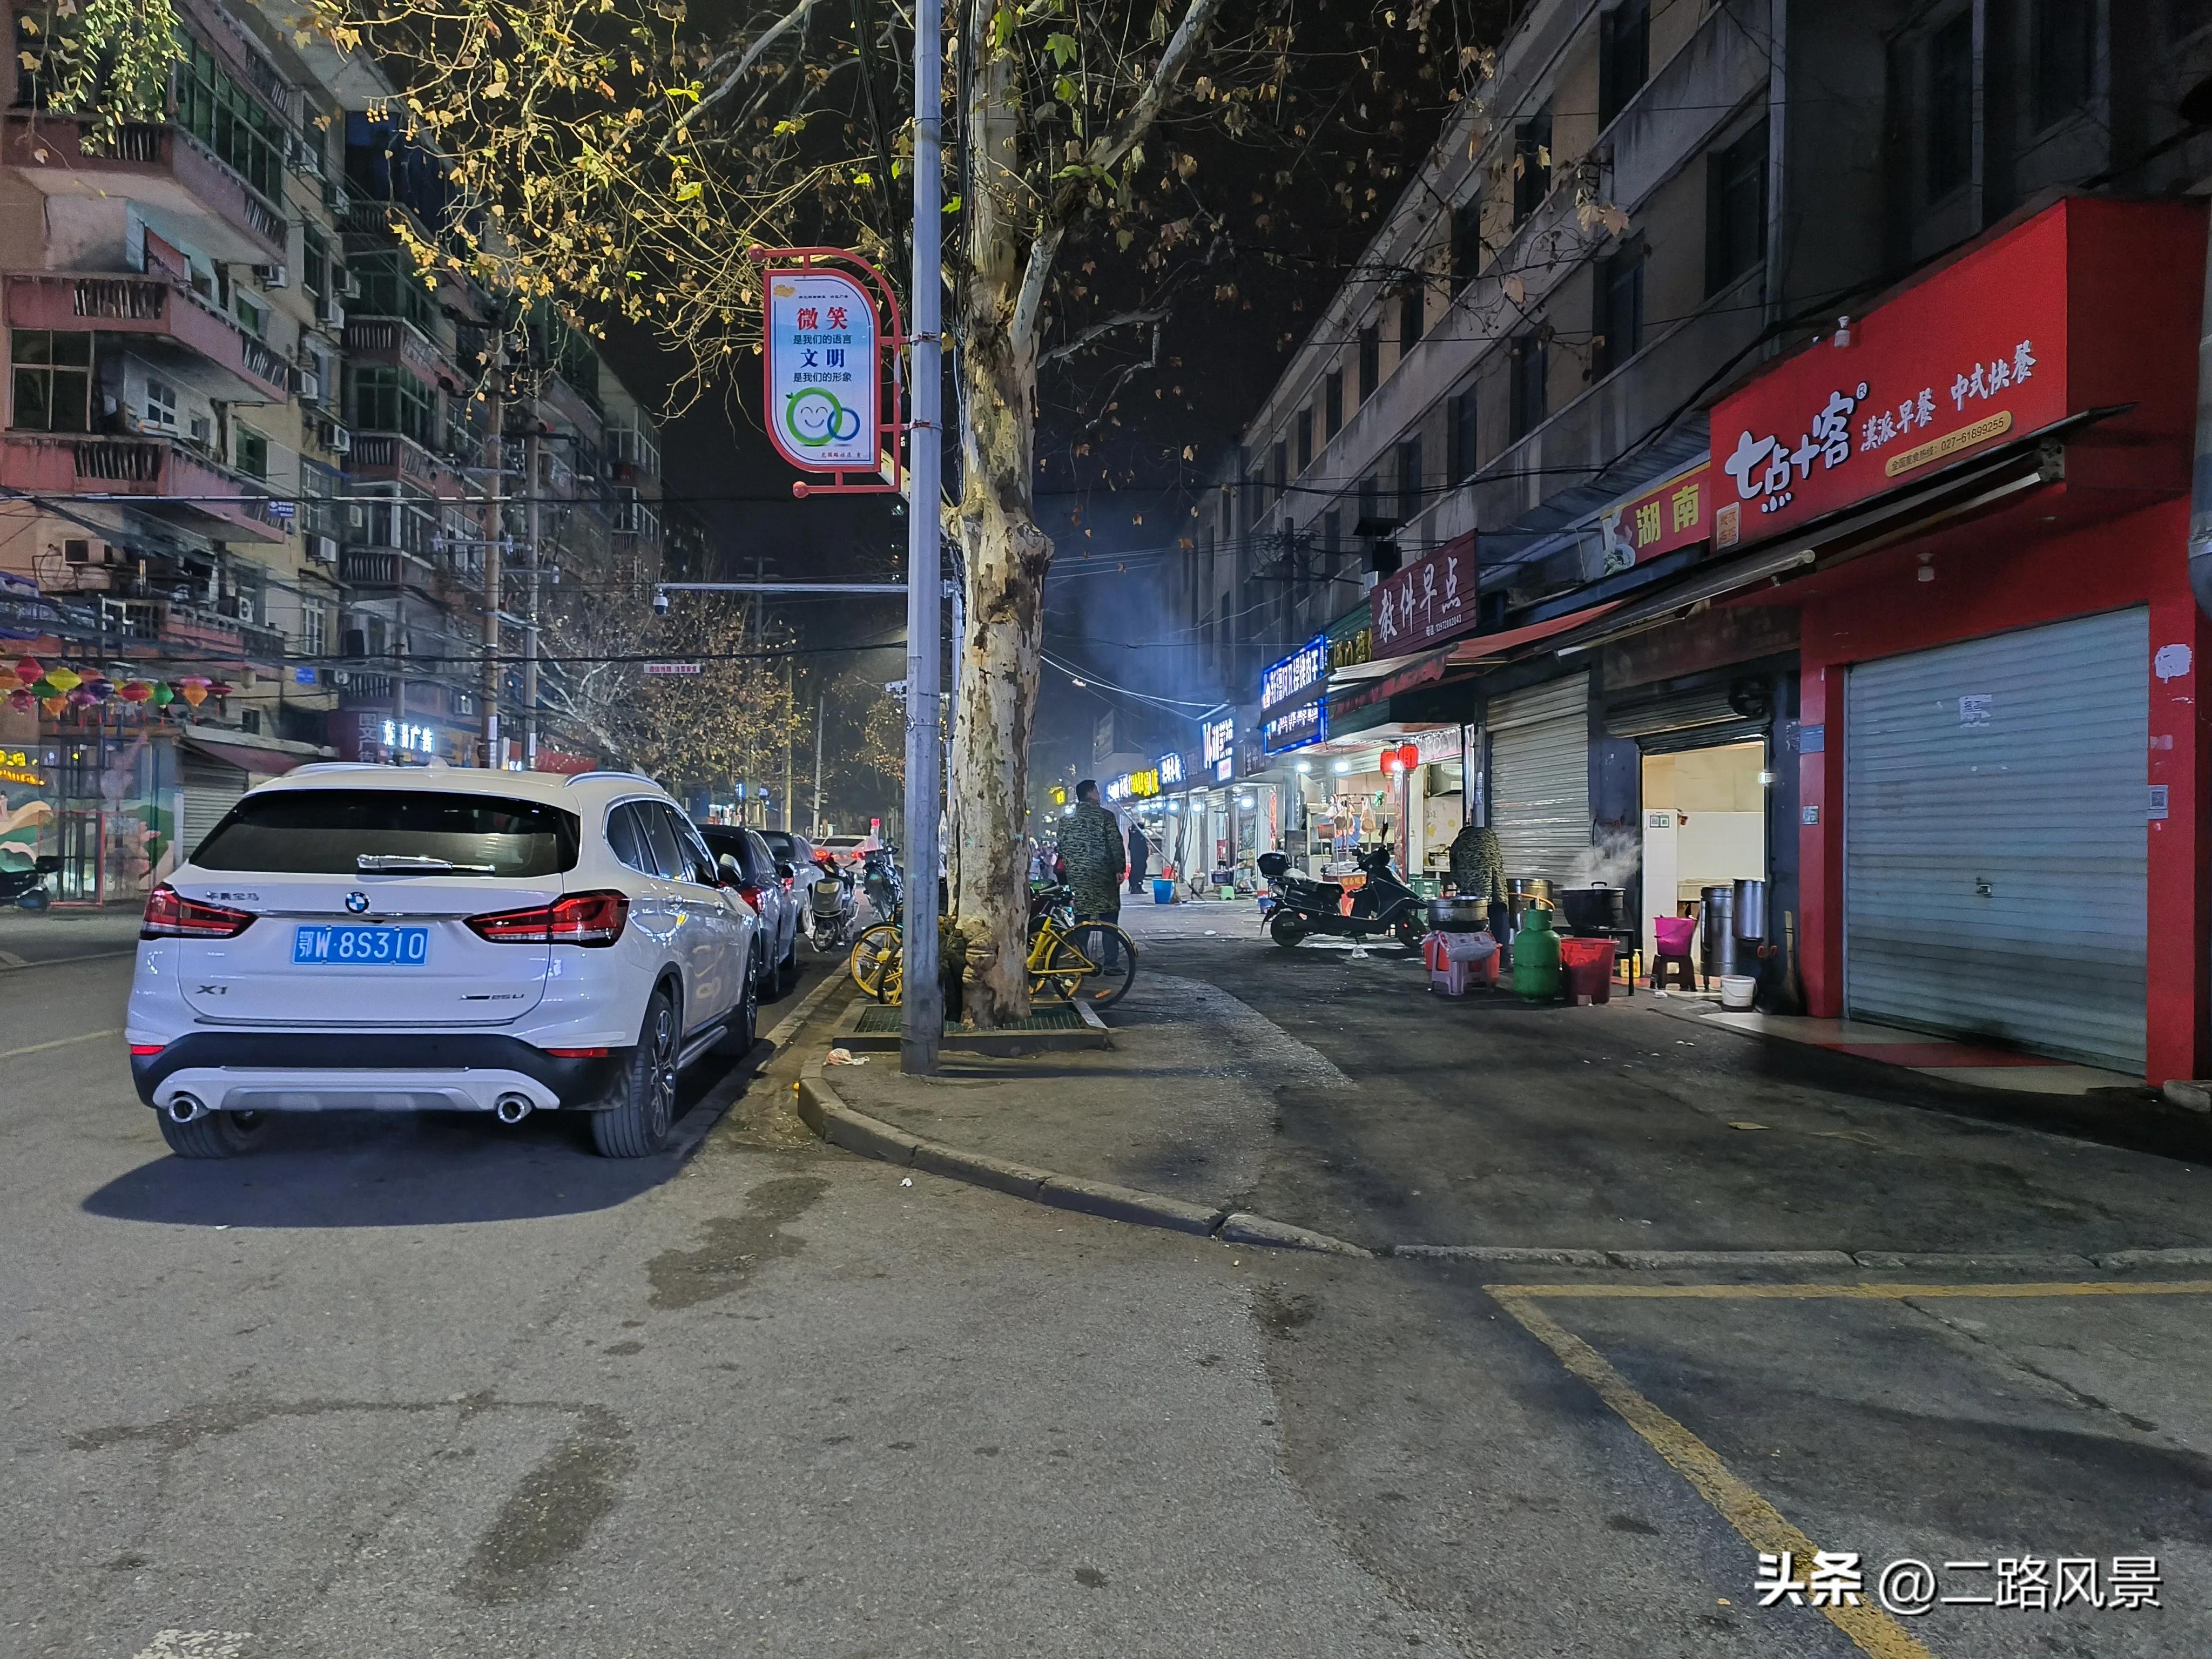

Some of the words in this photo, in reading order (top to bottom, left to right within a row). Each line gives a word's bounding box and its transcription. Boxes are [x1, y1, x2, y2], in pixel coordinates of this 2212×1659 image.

[797, 307, 848, 331] 微笑
[793, 334, 852, 345] 是我们的语言
[800, 348, 845, 368] 文明
[793, 372, 852, 382] 是我们的形象
[1951, 339, 2036, 410] 中式快餐
[1636, 483, 1699, 548] 湖南
[196, 984, 227, 994] X1
